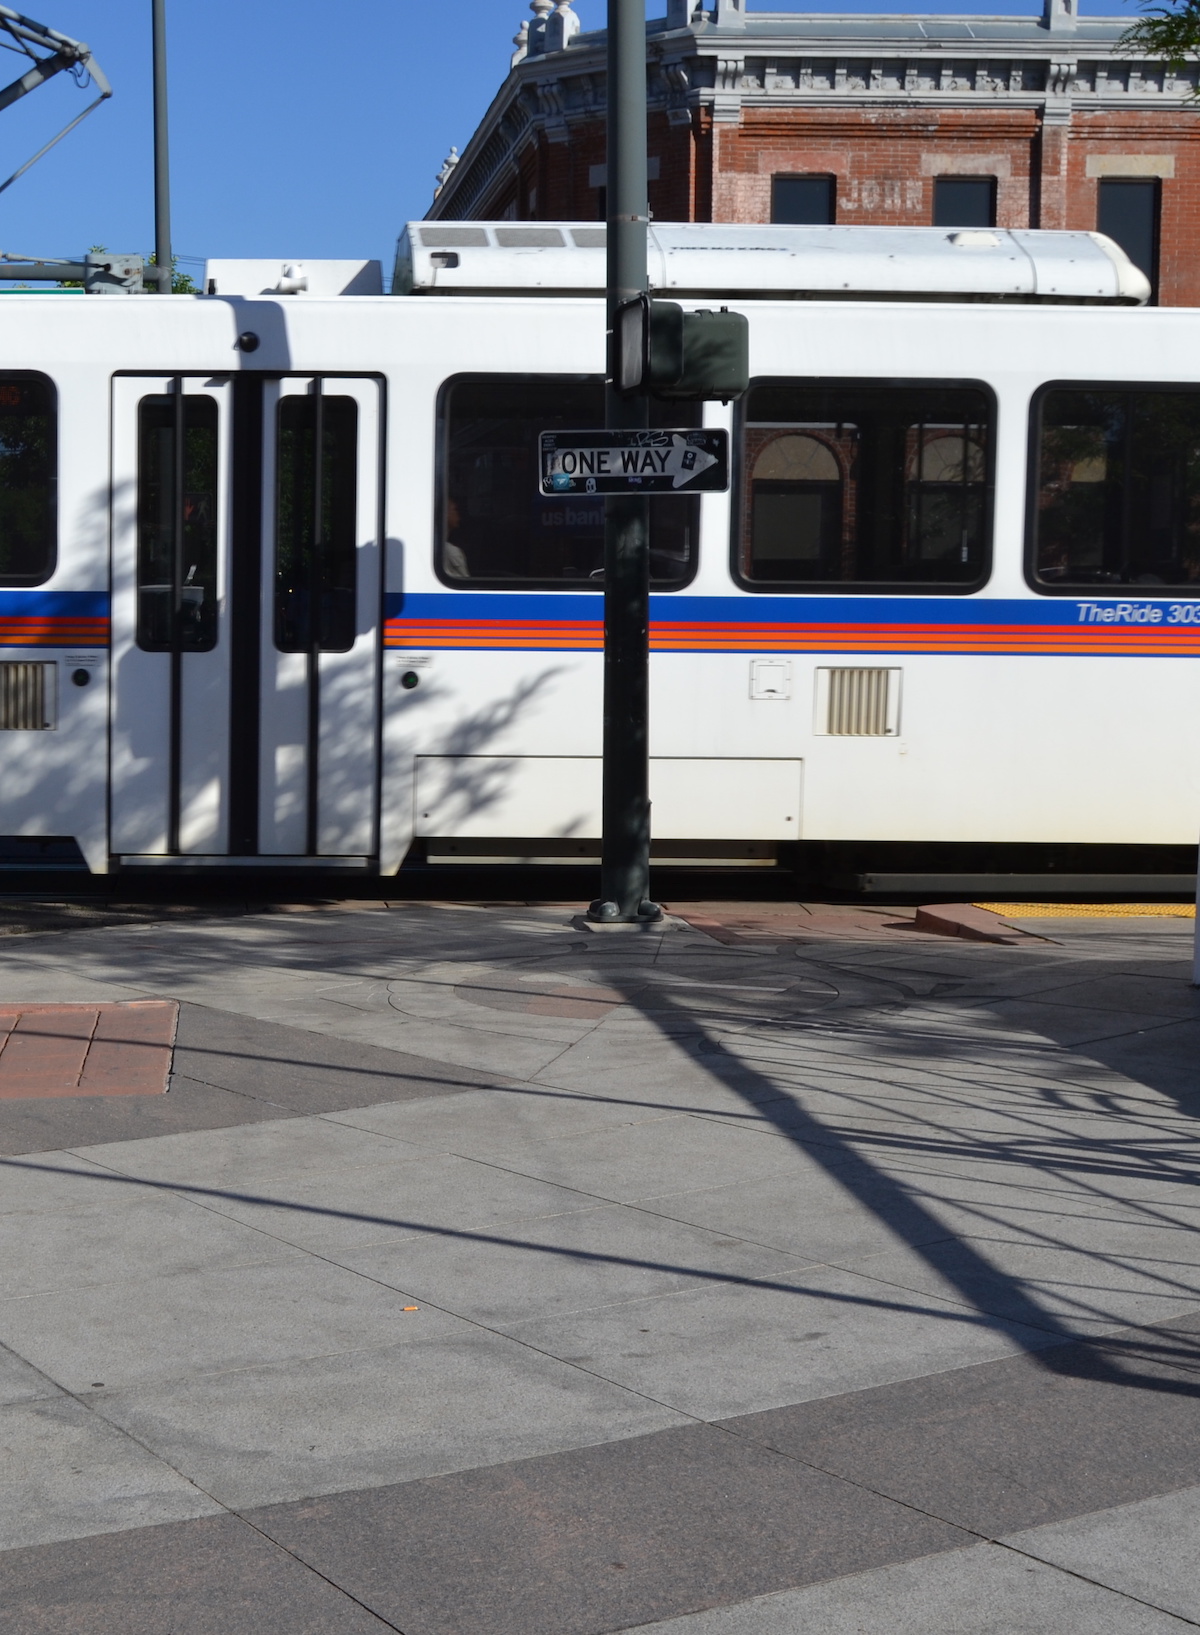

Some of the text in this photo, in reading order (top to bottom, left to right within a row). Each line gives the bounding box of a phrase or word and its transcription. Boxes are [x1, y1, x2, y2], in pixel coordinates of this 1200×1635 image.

[839, 178, 923, 211] JOHN
[561, 450, 671, 474] ONE WAY
[1076, 603, 1163, 623] TheRide
